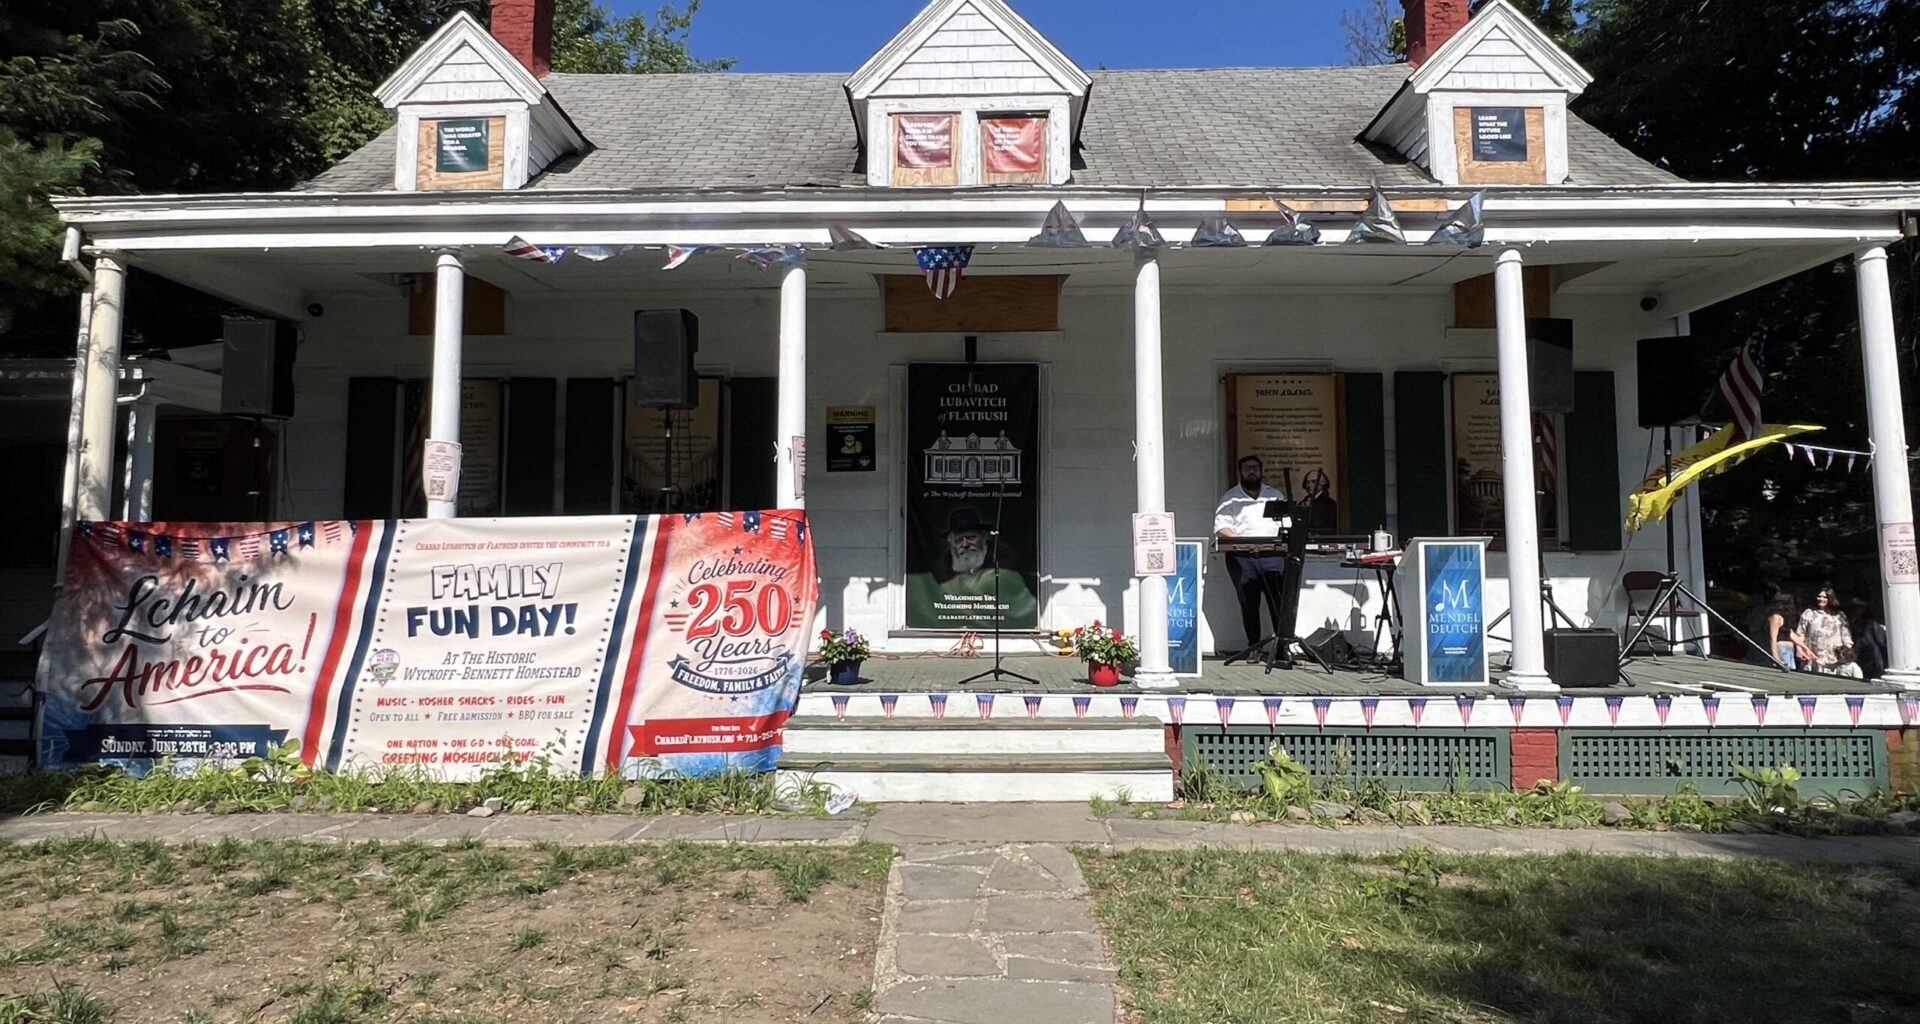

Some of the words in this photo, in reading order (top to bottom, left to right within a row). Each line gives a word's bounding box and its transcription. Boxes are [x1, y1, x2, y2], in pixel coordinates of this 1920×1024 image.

[948, 384, 998, 393] CHBAD
[940, 397, 1006, 407] LUBAVITCH
[937, 411, 947, 424] of
[949, 411, 1008, 421] FLATBUSH
[688, 557, 787, 584] Celebrating
[431, 562, 563, 600] FAMILY
[686, 580, 792, 644] 250
[1429, 613, 1480, 623] MENDEL
[407, 605, 480, 639] FUN
[491, 603, 578, 637] DAY!
[198, 624, 236, 647] to
[1431, 624, 1478, 634] DEUTCH
[462, 651, 484, 664] THE
[694, 636, 786, 672] Years
[80, 612, 317, 711] America!
[515, 666, 581, 679] HOMESTEAD
[714, 667, 758, 676] 1776-2026
[677, 669, 721, 692] FREEDOM,
[723, 680, 755, 692] FAMILY
[755, 679, 763, 688] &
[377, 697, 407, 706] MUSIC
[418, 696, 454, 706] KOSHER
[458, 696, 495, 706] SNACKS
[507, 696, 534, 705] RIDES
[546, 695, 565, 704] FUN
[370, 712, 390, 722] OPEN
[405, 713, 420, 721] ALL
[437, 711, 457, 721] FREE
[460, 712, 503, 721] ADMISSION
[518, 710, 536, 721] BBQ
[537, 711, 552, 720] FOR
[554, 711, 574, 720] SALE
[101, 738, 147, 754] SUNDAY,
[150, 738, 178, 753] JUNE
[179, 740, 207, 753] 28TH
[239, 741, 256, 754] PM
[387, 739, 403, 748] ONE
[407, 740, 438, 748] NATION
[451, 739, 467, 747] ONE
[382, 752, 437, 764] GREETING
